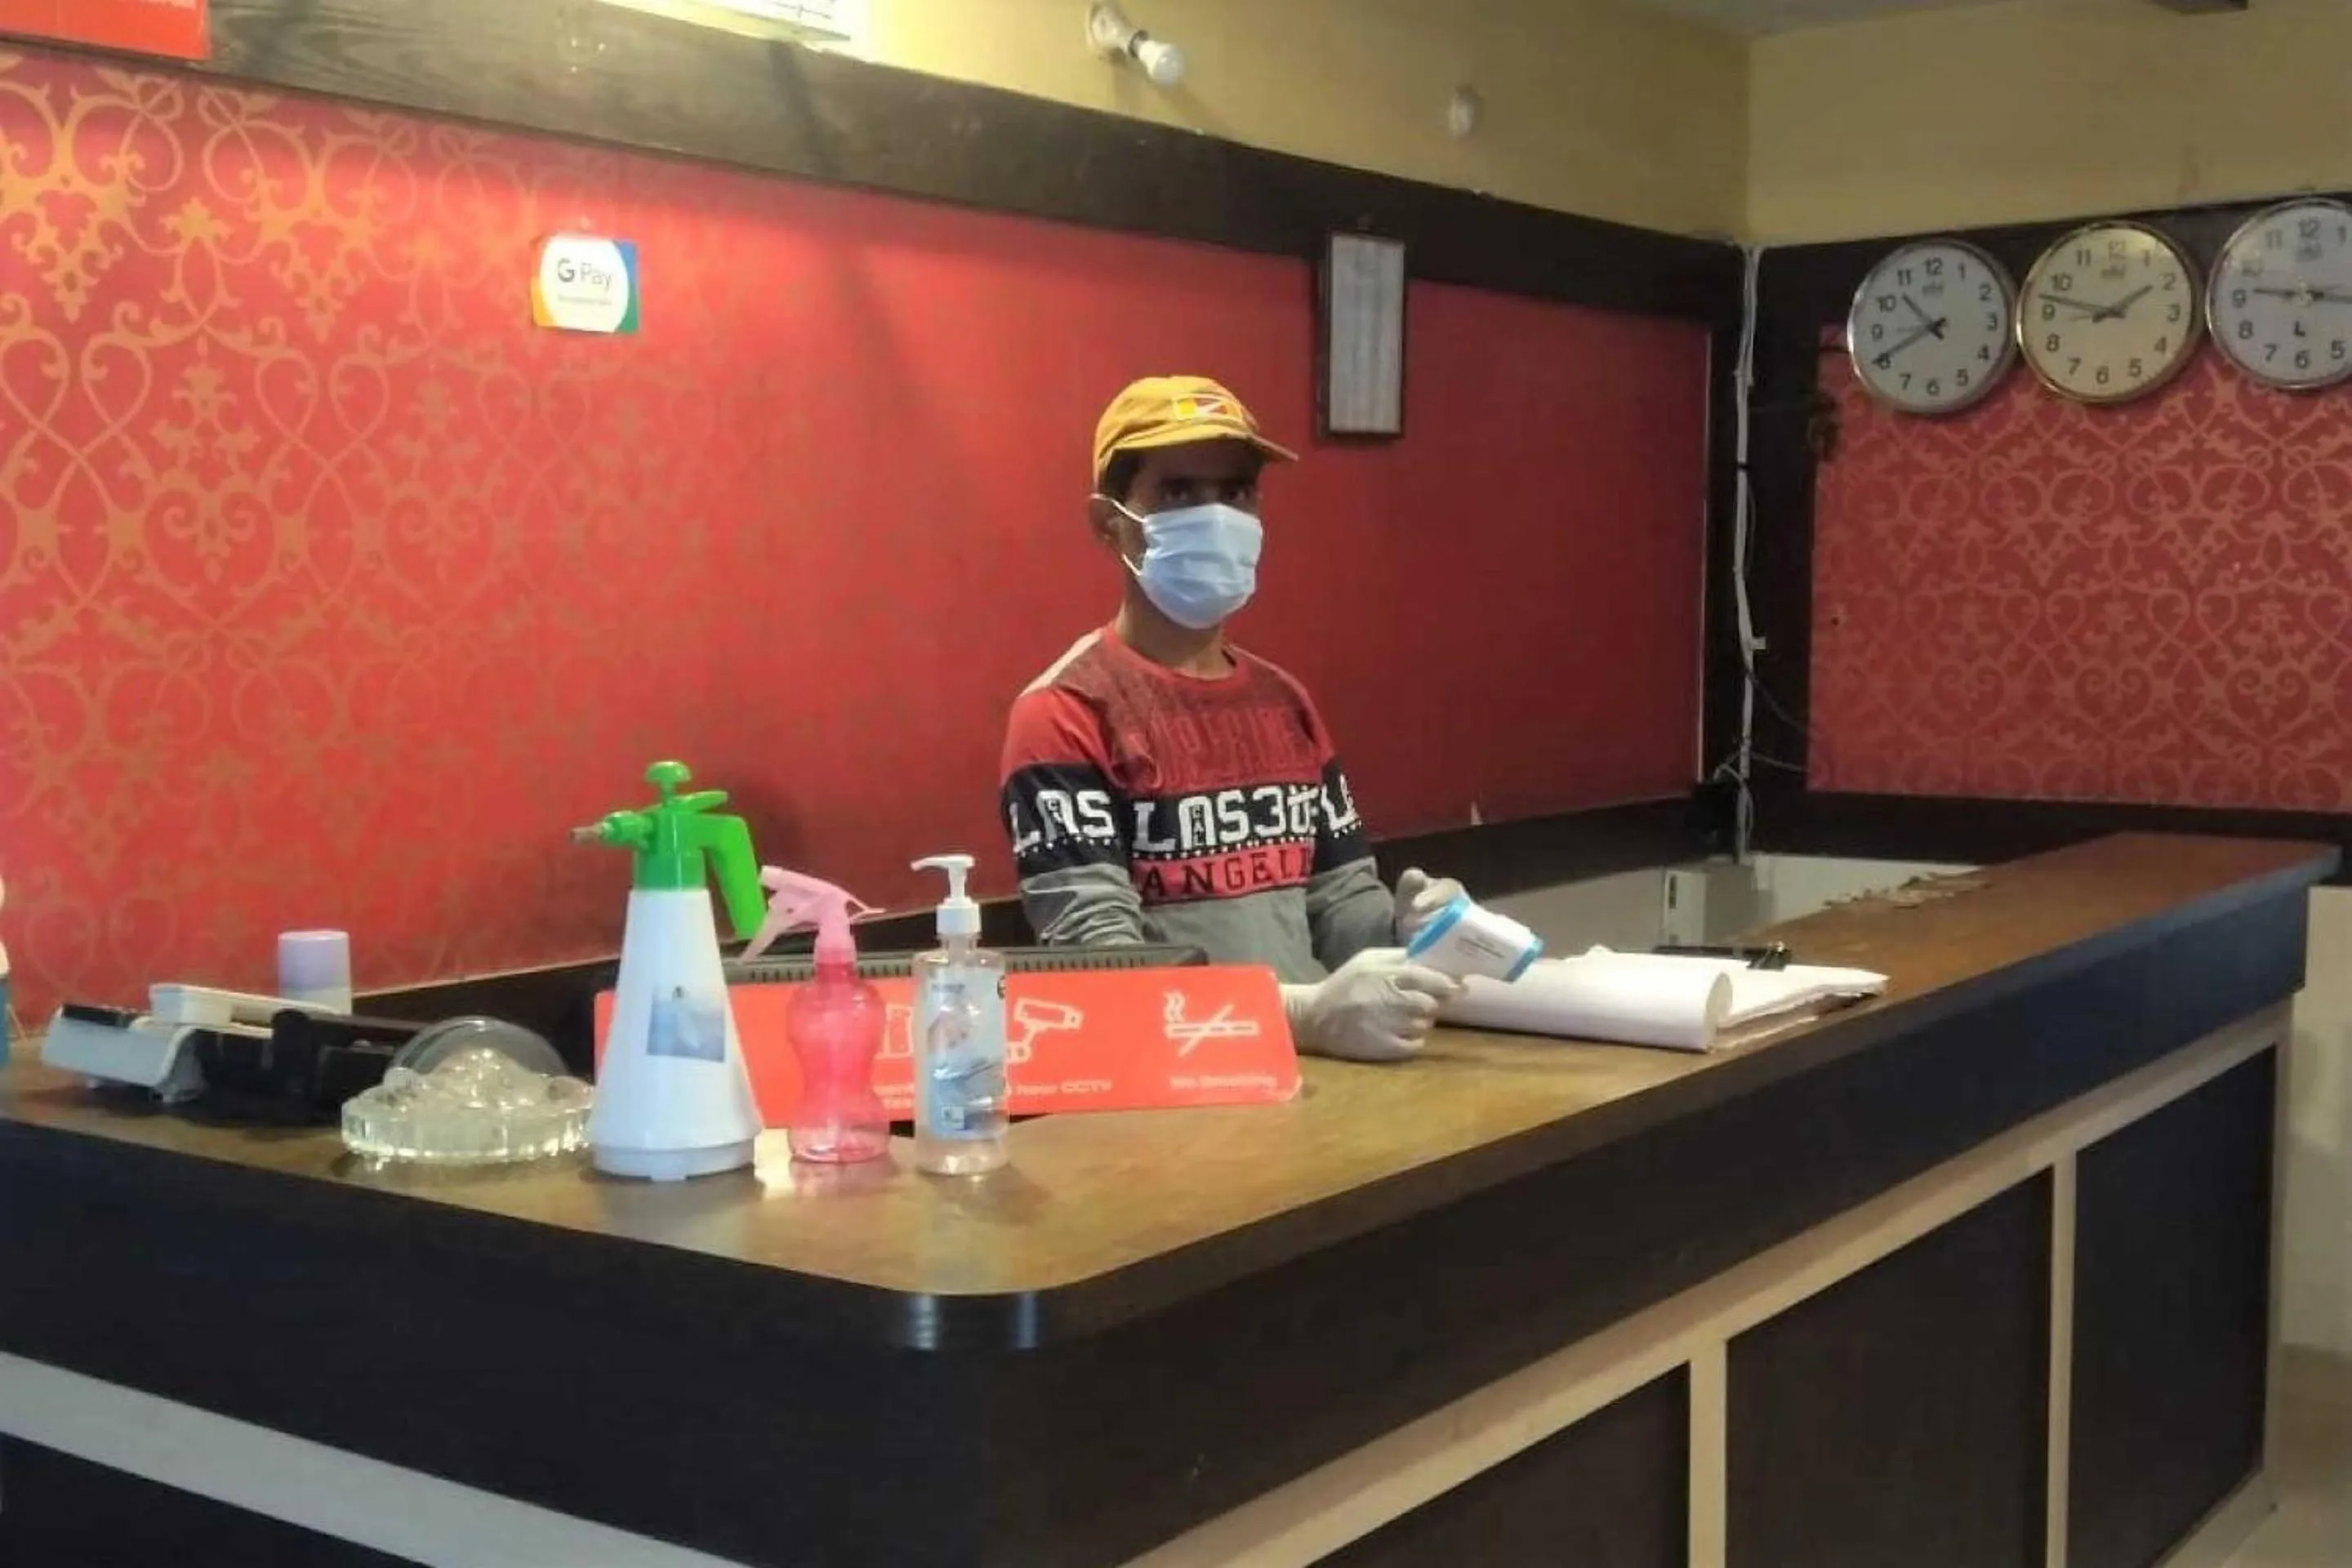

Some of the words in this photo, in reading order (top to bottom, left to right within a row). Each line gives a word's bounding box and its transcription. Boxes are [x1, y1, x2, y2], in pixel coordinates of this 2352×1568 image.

[1924, 257, 1943, 275] 12
[2076, 249, 2091, 266] 11
[1897, 269, 1911, 285] 11
[2051, 274, 2072, 292] 10
[2163, 272, 2176, 291] 2
[1980, 284, 1992, 301] 2
[2232, 288, 2247, 308] 9
[1878, 295, 1896, 312] 10
[2042, 303, 2056, 321] 9
[2167, 304, 2180, 323] 3
[1871, 324, 1883, 340] 9
[2238, 320, 2253, 340] 8
[2045, 333, 2060, 352] 8
[2154, 336, 2167, 353] 4
[2331, 340, 2345, 360] 5
[1977, 344, 1989, 360] 4
[2264, 343, 2277, 362] 7
[2294, 350, 2309, 370] 6
[2067, 357, 2081, 376] 7
[2096, 366, 2109, 384] 6
[2128, 358, 2141, 377] 5
[1899, 372, 1912, 390] 7
[1956, 368, 1969, 386] 5
[1926, 379, 1940, 396] 6
